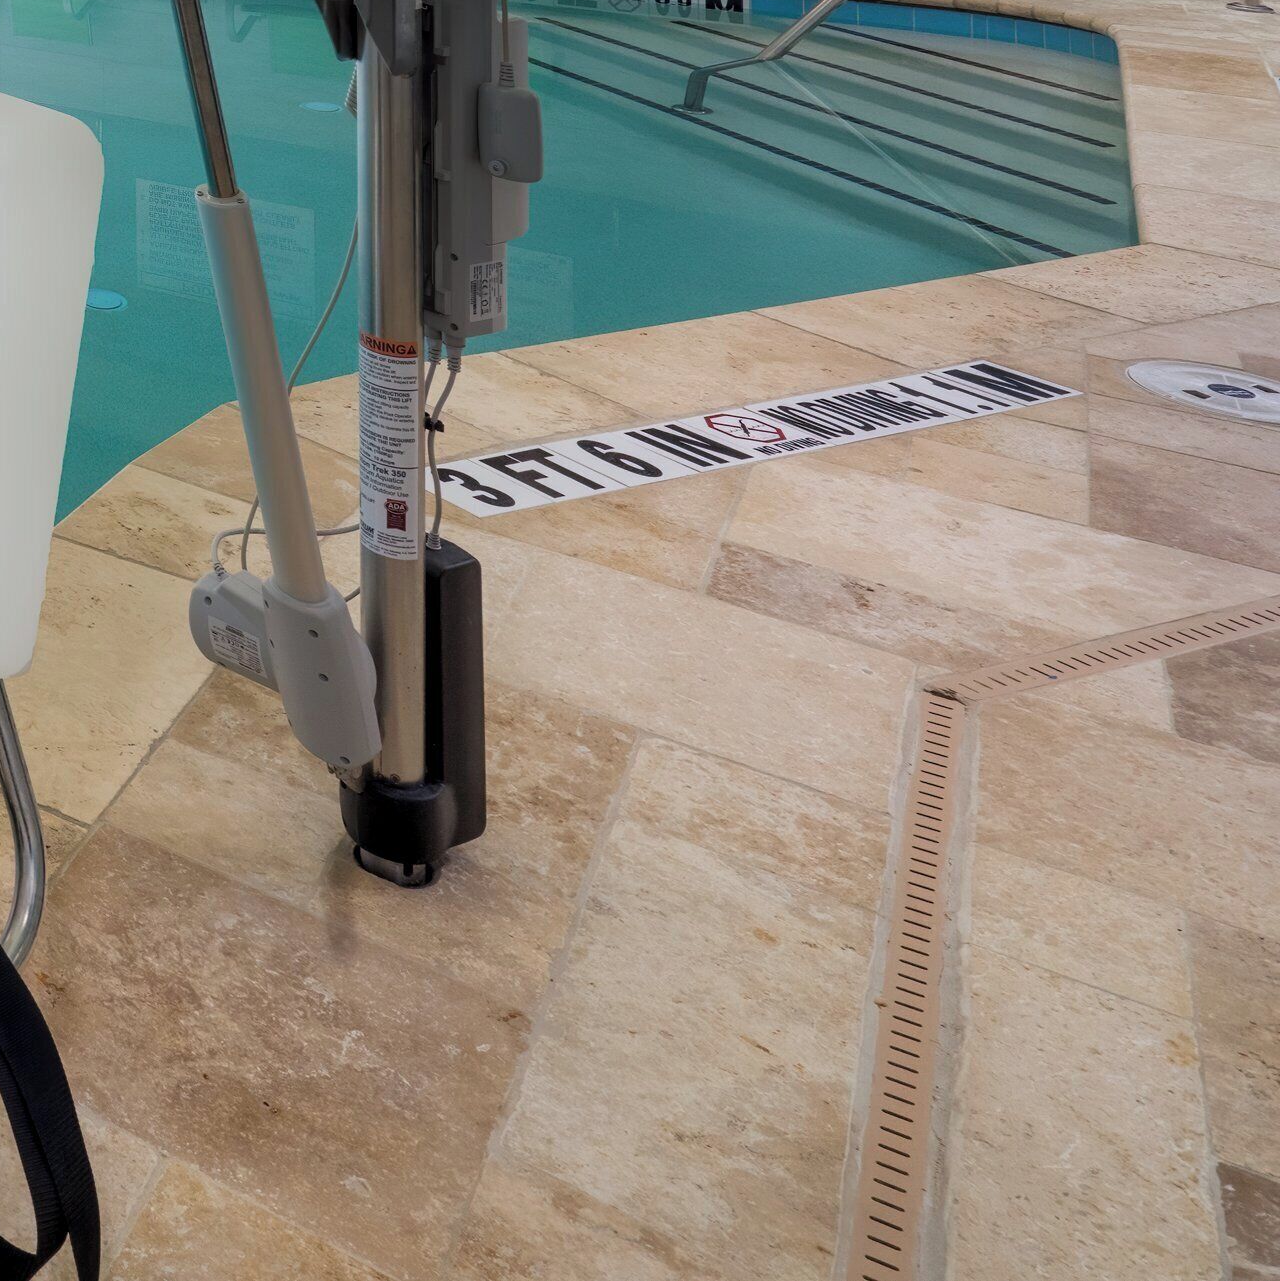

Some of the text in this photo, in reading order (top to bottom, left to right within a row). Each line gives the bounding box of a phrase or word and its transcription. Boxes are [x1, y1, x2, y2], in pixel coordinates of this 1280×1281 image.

[361, 333, 406, 355] ARNING
[438, 362, 1072, 509] 3 FT 6 IN NO DIVING 1.1 M
[753, 436, 828, 457] NO DIVING
[371, 463, 389, 476] Trek
[391, 469, 407, 478] 350
[387, 502, 406, 511] ADA
